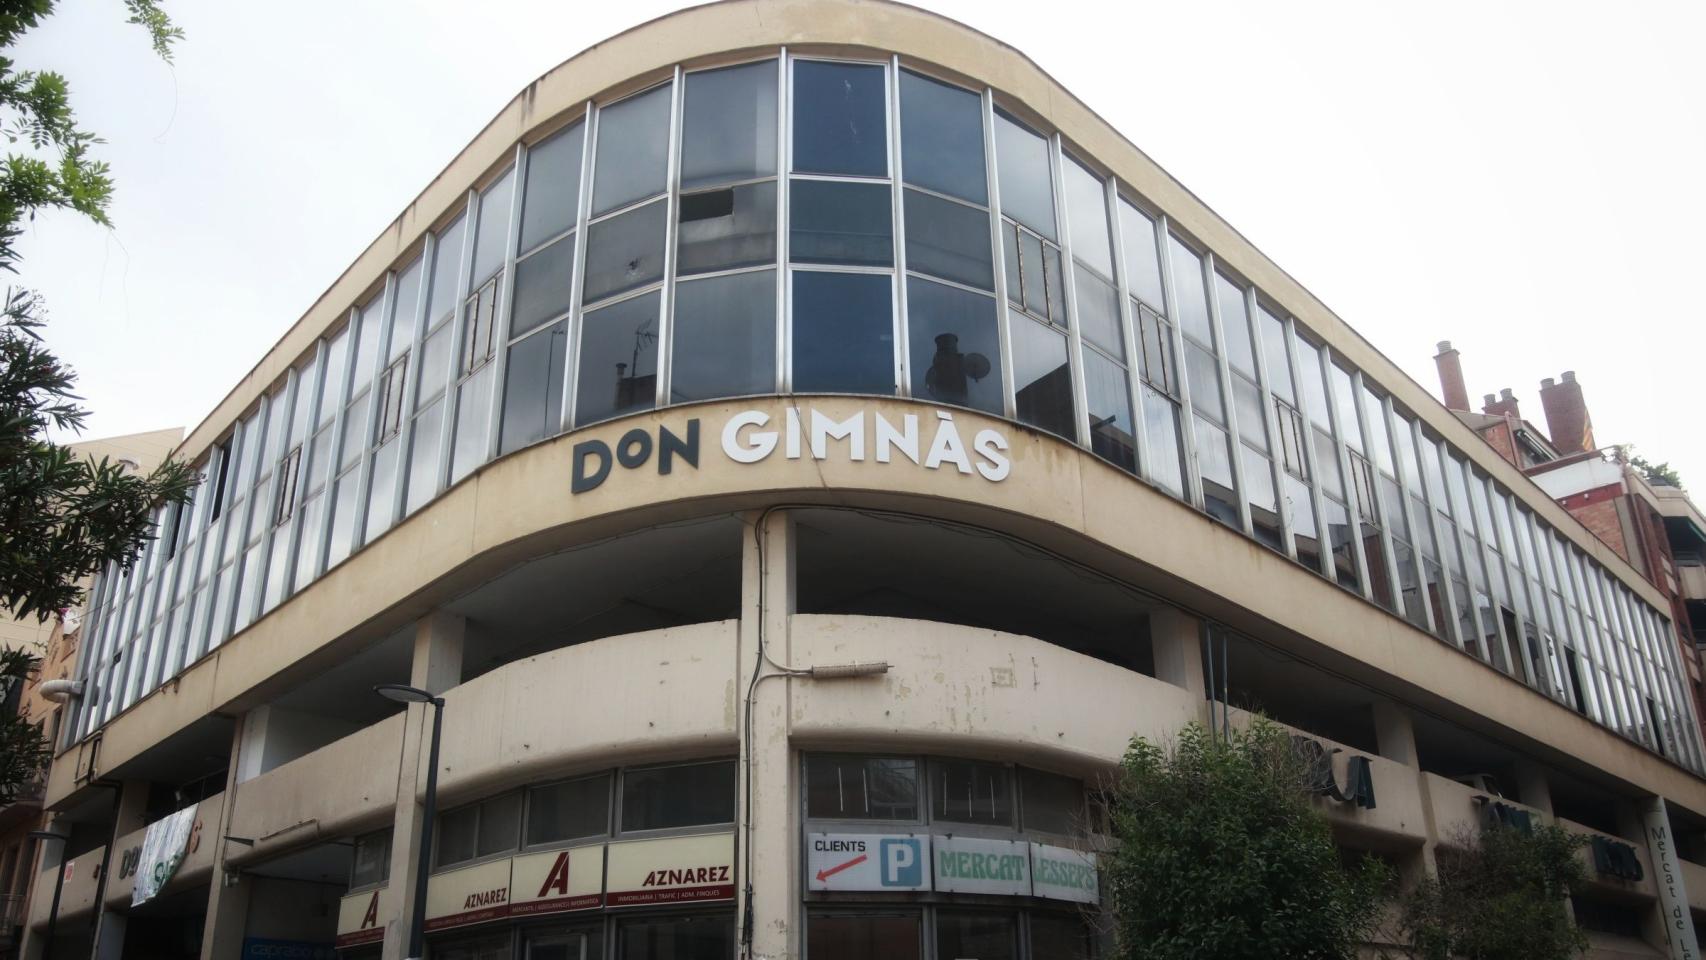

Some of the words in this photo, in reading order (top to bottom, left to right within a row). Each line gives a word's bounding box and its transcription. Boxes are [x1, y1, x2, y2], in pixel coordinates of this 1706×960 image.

[571, 418, 700, 494] DON
[815, 840, 866, 852] CLIENTS
[889, 843, 913, 882] P
[538, 851, 569, 897] A
[642, 865, 729, 887] AZNAREZ
[940, 851, 1025, 881] MERCAT
[1033, 856, 1095, 889] LESSEPS
[1651, 827, 1676, 897] Mercat
[1673, 905, 1685, 930] de
[360, 890, 379, 930] A
[463, 887, 507, 910] AZNAREZ
